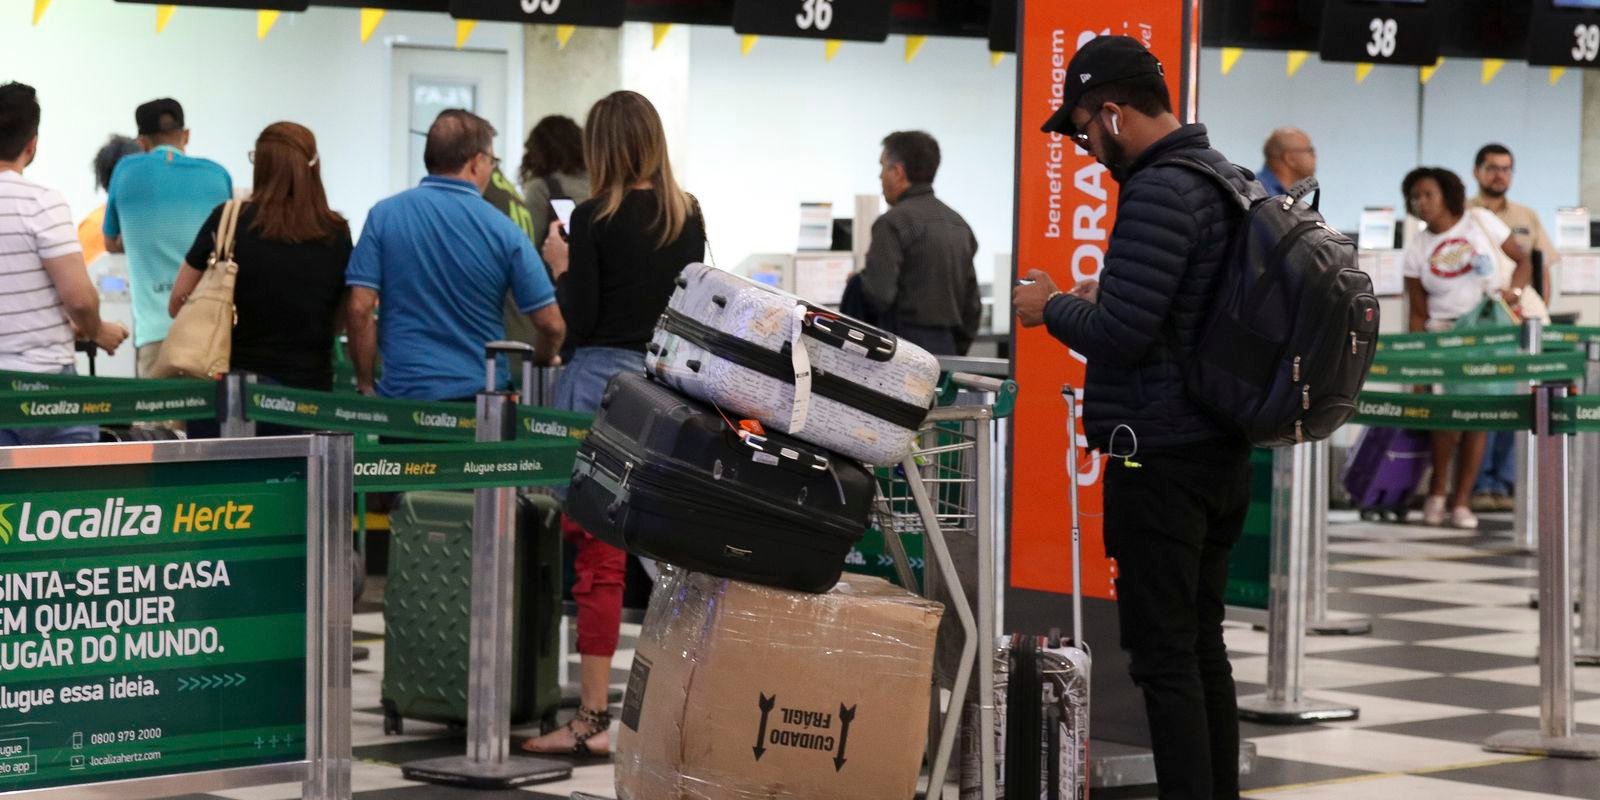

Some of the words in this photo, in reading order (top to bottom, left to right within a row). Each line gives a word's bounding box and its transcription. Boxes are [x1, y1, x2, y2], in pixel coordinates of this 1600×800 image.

[795, 0, 832, 30] 36
[1366, 18, 1398, 57] 38
[1571, 24, 1600, 61] 39
[30, 401, 80, 416] Localiza
[82, 402, 112, 414] Hertz
[135, 400, 164, 412] Alugue
[166, 400, 185, 408] essa
[186, 397, 207, 408] ideia.
[260, 395, 296, 412] Localiza
[419, 412, 457, 428] Localiza
[1359, 402, 1402, 417] Localiza
[1576, 404, 1600, 420] Local
[530, 419, 567, 437] Localiza
[353, 459, 400, 476] ocaliza
[404, 462, 437, 475] Hertz
[463, 461, 495, 476] Alugue
[497, 462, 518, 472] essa
[520, 459, 543, 472] ideia.
[18, 497, 162, 541] Localiza
[172, 501, 254, 533] Hertz
[117, 564, 155, 593] EM
[163, 560, 230, 590] CASA
[35, 596, 175, 637] QUALQUER
[0, 638, 74, 671] UGAR
[82, 635, 117, 664] DO
[125, 626, 224, 660] MUNDO.
[0, 686, 54, 713] lugue
[60, 683, 104, 703] essa
[110, 675, 160, 699] ideia.
[781, 707, 832, 729] FRÁGIL
[91, 732, 115, 744] 0800
[117, 730, 135, 743] 979
[138, 728, 161, 740] 2000
[770, 729, 834, 751] CUIDADO
[0, 745, 22, 757] ugue
[0, 761, 11, 773] elo
[13, 761, 30, 773] app
